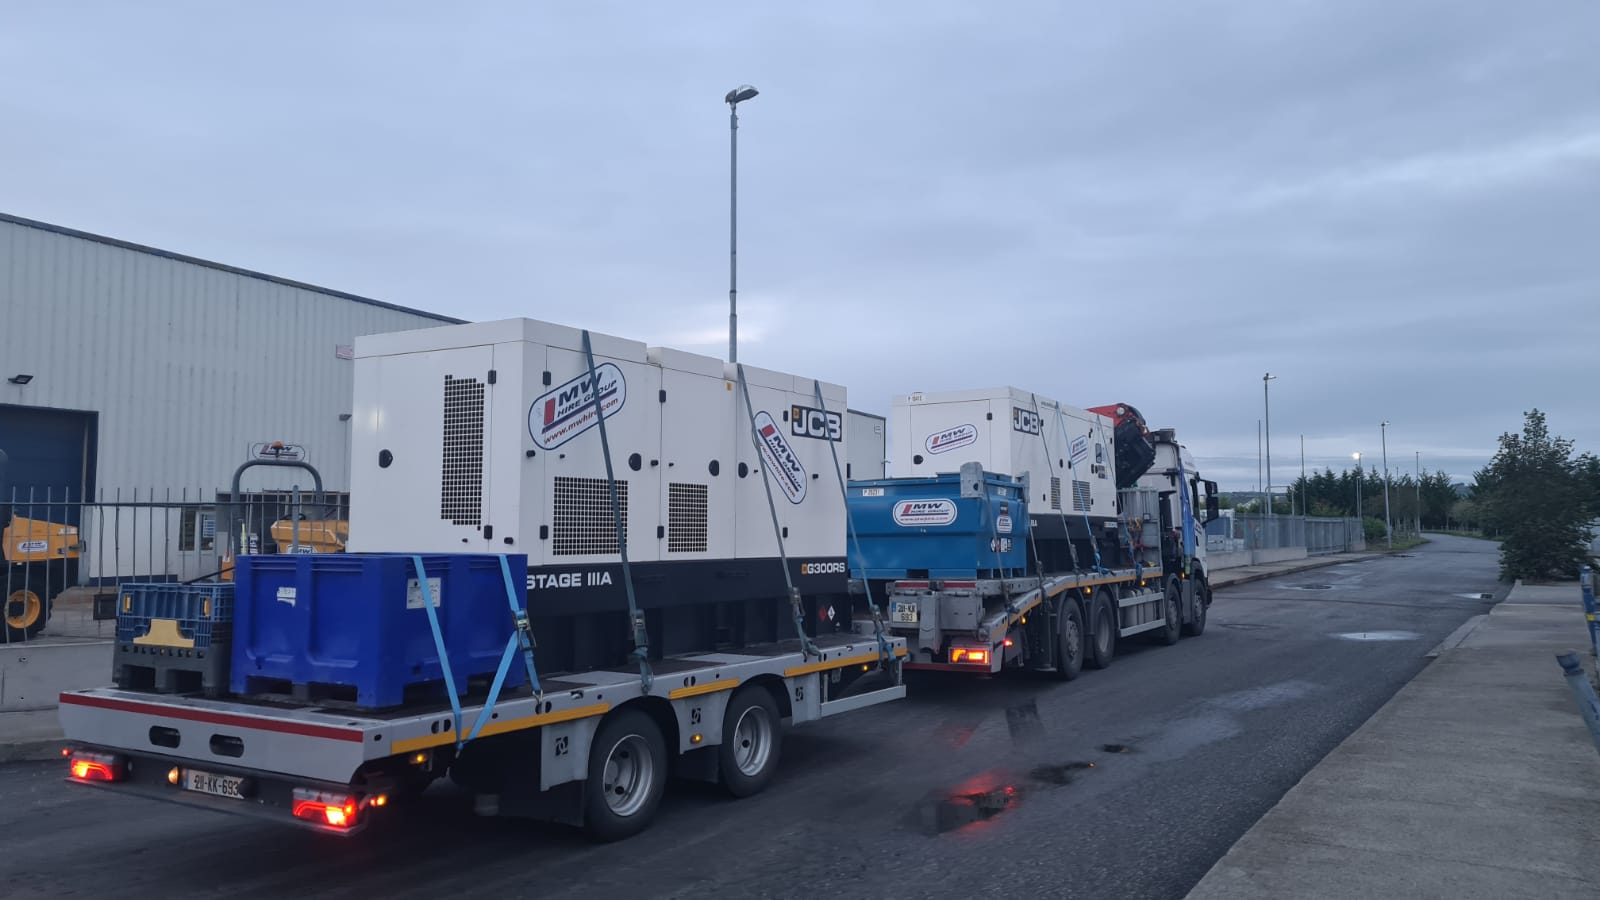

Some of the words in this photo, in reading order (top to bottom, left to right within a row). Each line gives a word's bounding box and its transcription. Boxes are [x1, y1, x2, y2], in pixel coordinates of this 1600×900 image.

[559, 372, 602, 407] MW
[557, 400, 580, 417] HIRE
[793, 409, 841, 439] JCB
[941, 428, 966, 439] MW
[1014, 409, 1039, 434] JCB
[769, 439, 783, 459] HIRE
[782, 461, 802, 488] GROUP
[773, 435, 800, 472] MW
[527, 573, 581, 590] STAGE
[587, 571, 612, 586] IIIA
[807, 562, 846, 574] G300RS
